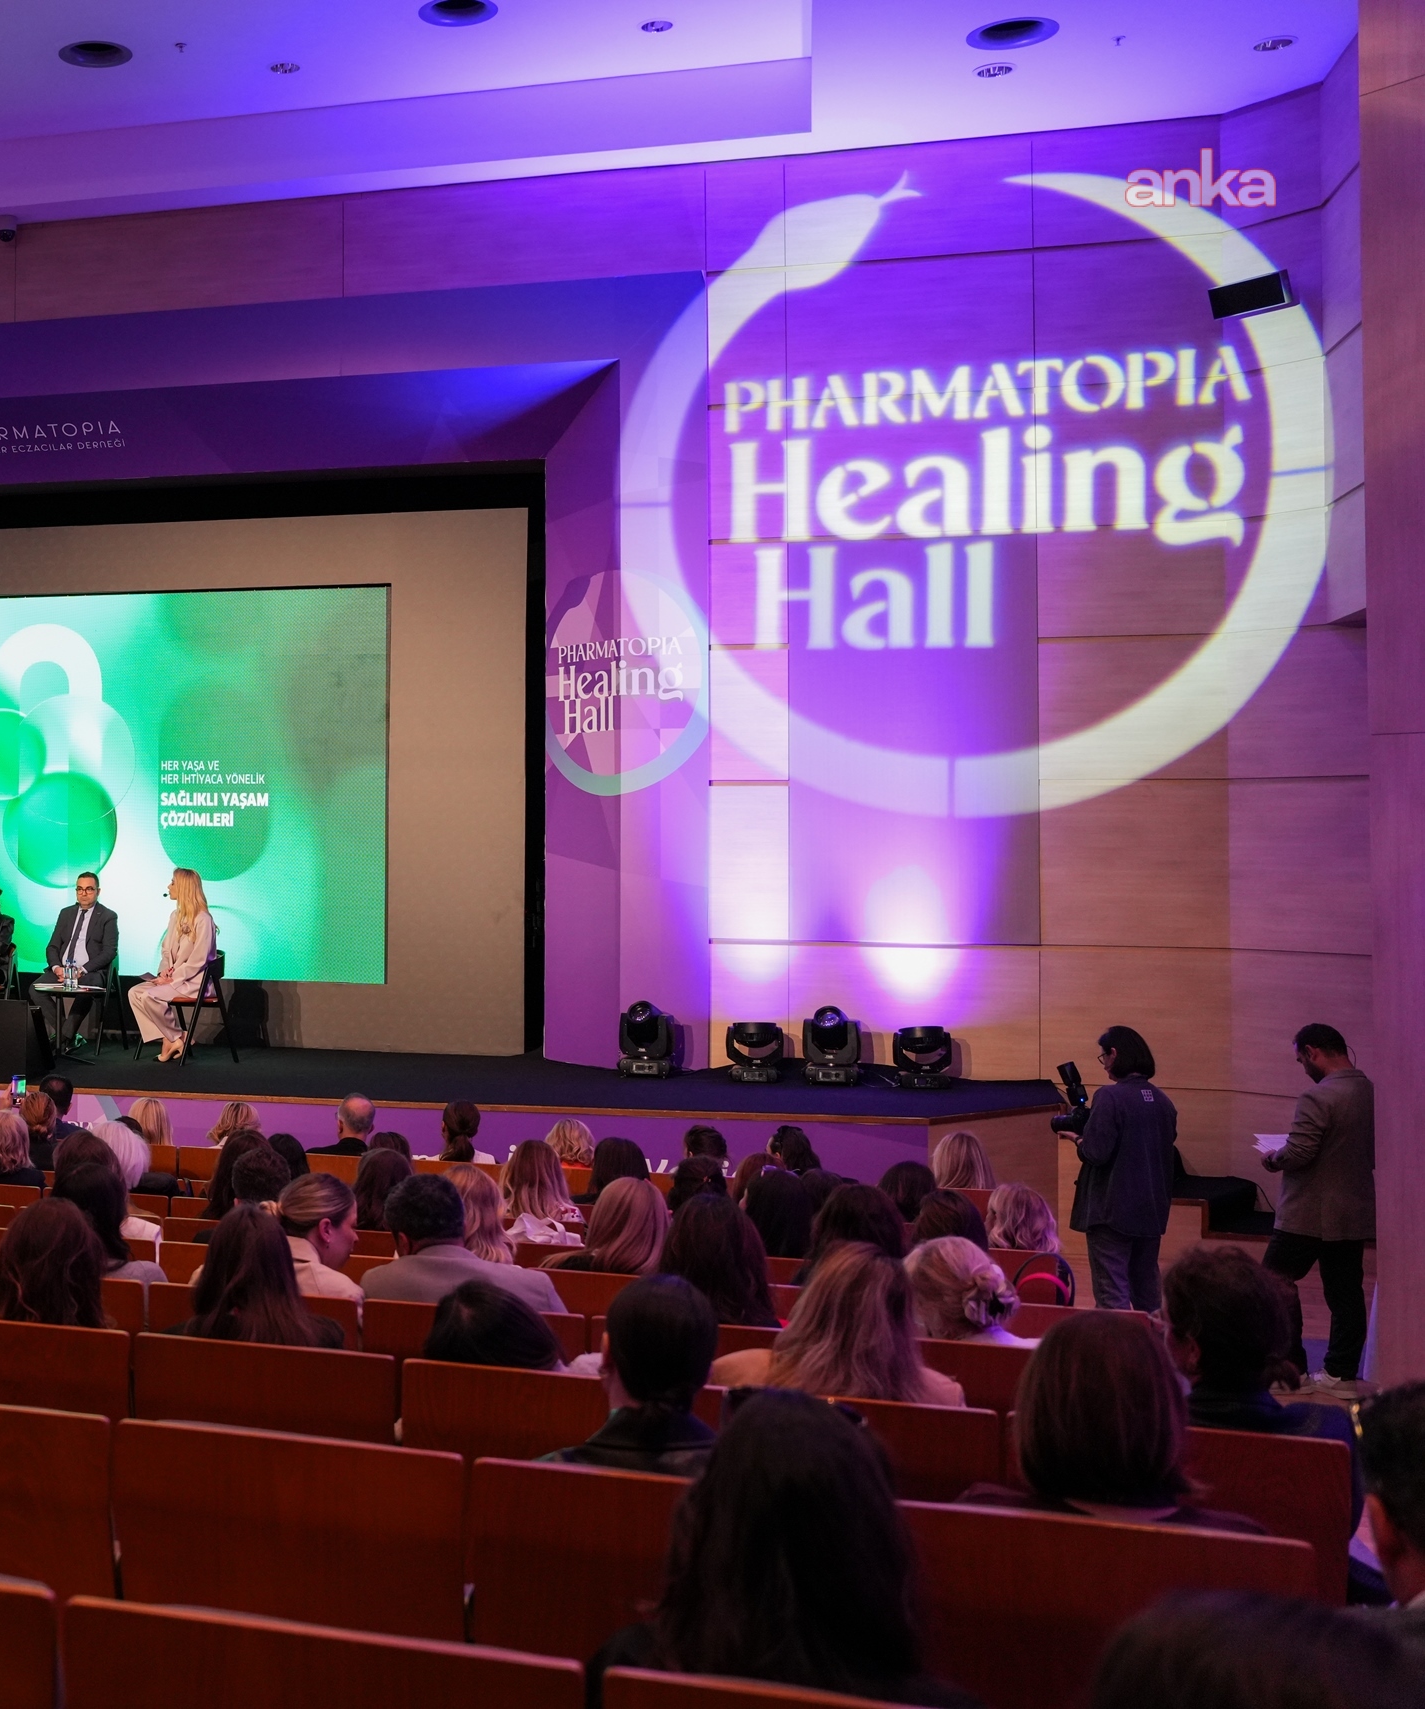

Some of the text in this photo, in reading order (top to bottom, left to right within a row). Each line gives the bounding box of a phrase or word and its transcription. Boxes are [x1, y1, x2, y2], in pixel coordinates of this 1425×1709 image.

[723, 344, 1253, 434] PHARMATOPIA
[728, 426, 1247, 549] Healing
[752, 540, 996, 651] Hall
[558, 637, 683, 664] PHARMATOPIA
[558, 660, 684, 702] Healing
[564, 695, 615, 735] Hall
[160, 760, 220, 773] HER YAŞA VE
[160, 772, 265, 784] HER İHTİYACA YÖNELİK
[160, 790, 269, 810] SAĞLIKLI YAŞAM
[160, 810, 234, 829] ÇÖZÜMLERİ
